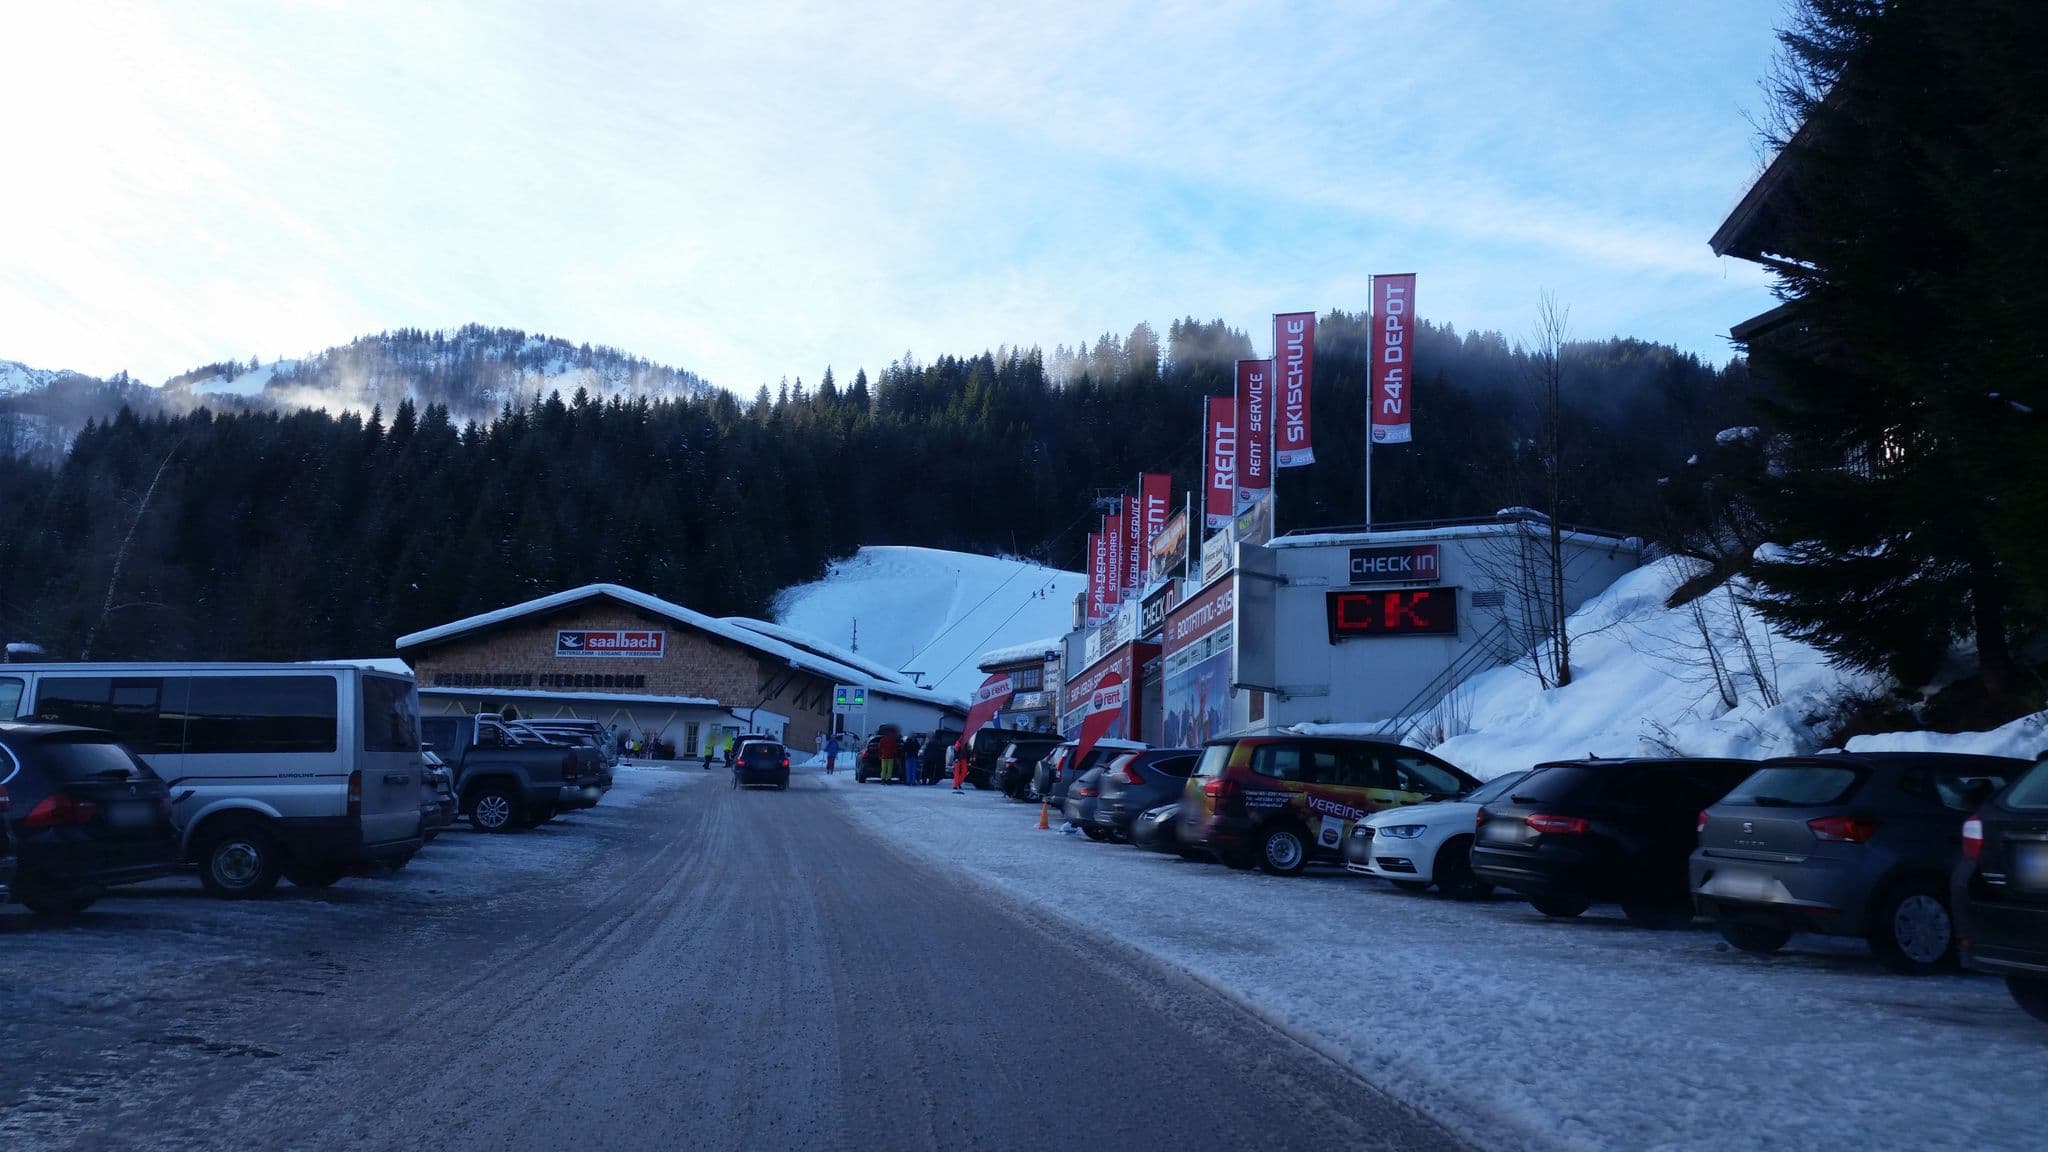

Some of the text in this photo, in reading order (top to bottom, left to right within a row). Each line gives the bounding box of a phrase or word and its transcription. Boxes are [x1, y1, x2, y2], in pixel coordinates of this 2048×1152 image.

[1383, 283, 1404, 415] 24h DEPOT
[1286, 319, 1305, 443] SKISCHULE
[1249, 372, 1263, 477] RENT SERVICE
[1214, 421, 1236, 490] RENT
[1350, 554, 1435, 574] CHECK IN
[1142, 594, 1166, 631] CHECK
[588, 631, 657, 648] saalbach
[991, 681, 1010, 696] rent
[1103, 690, 1121, 706] rent
